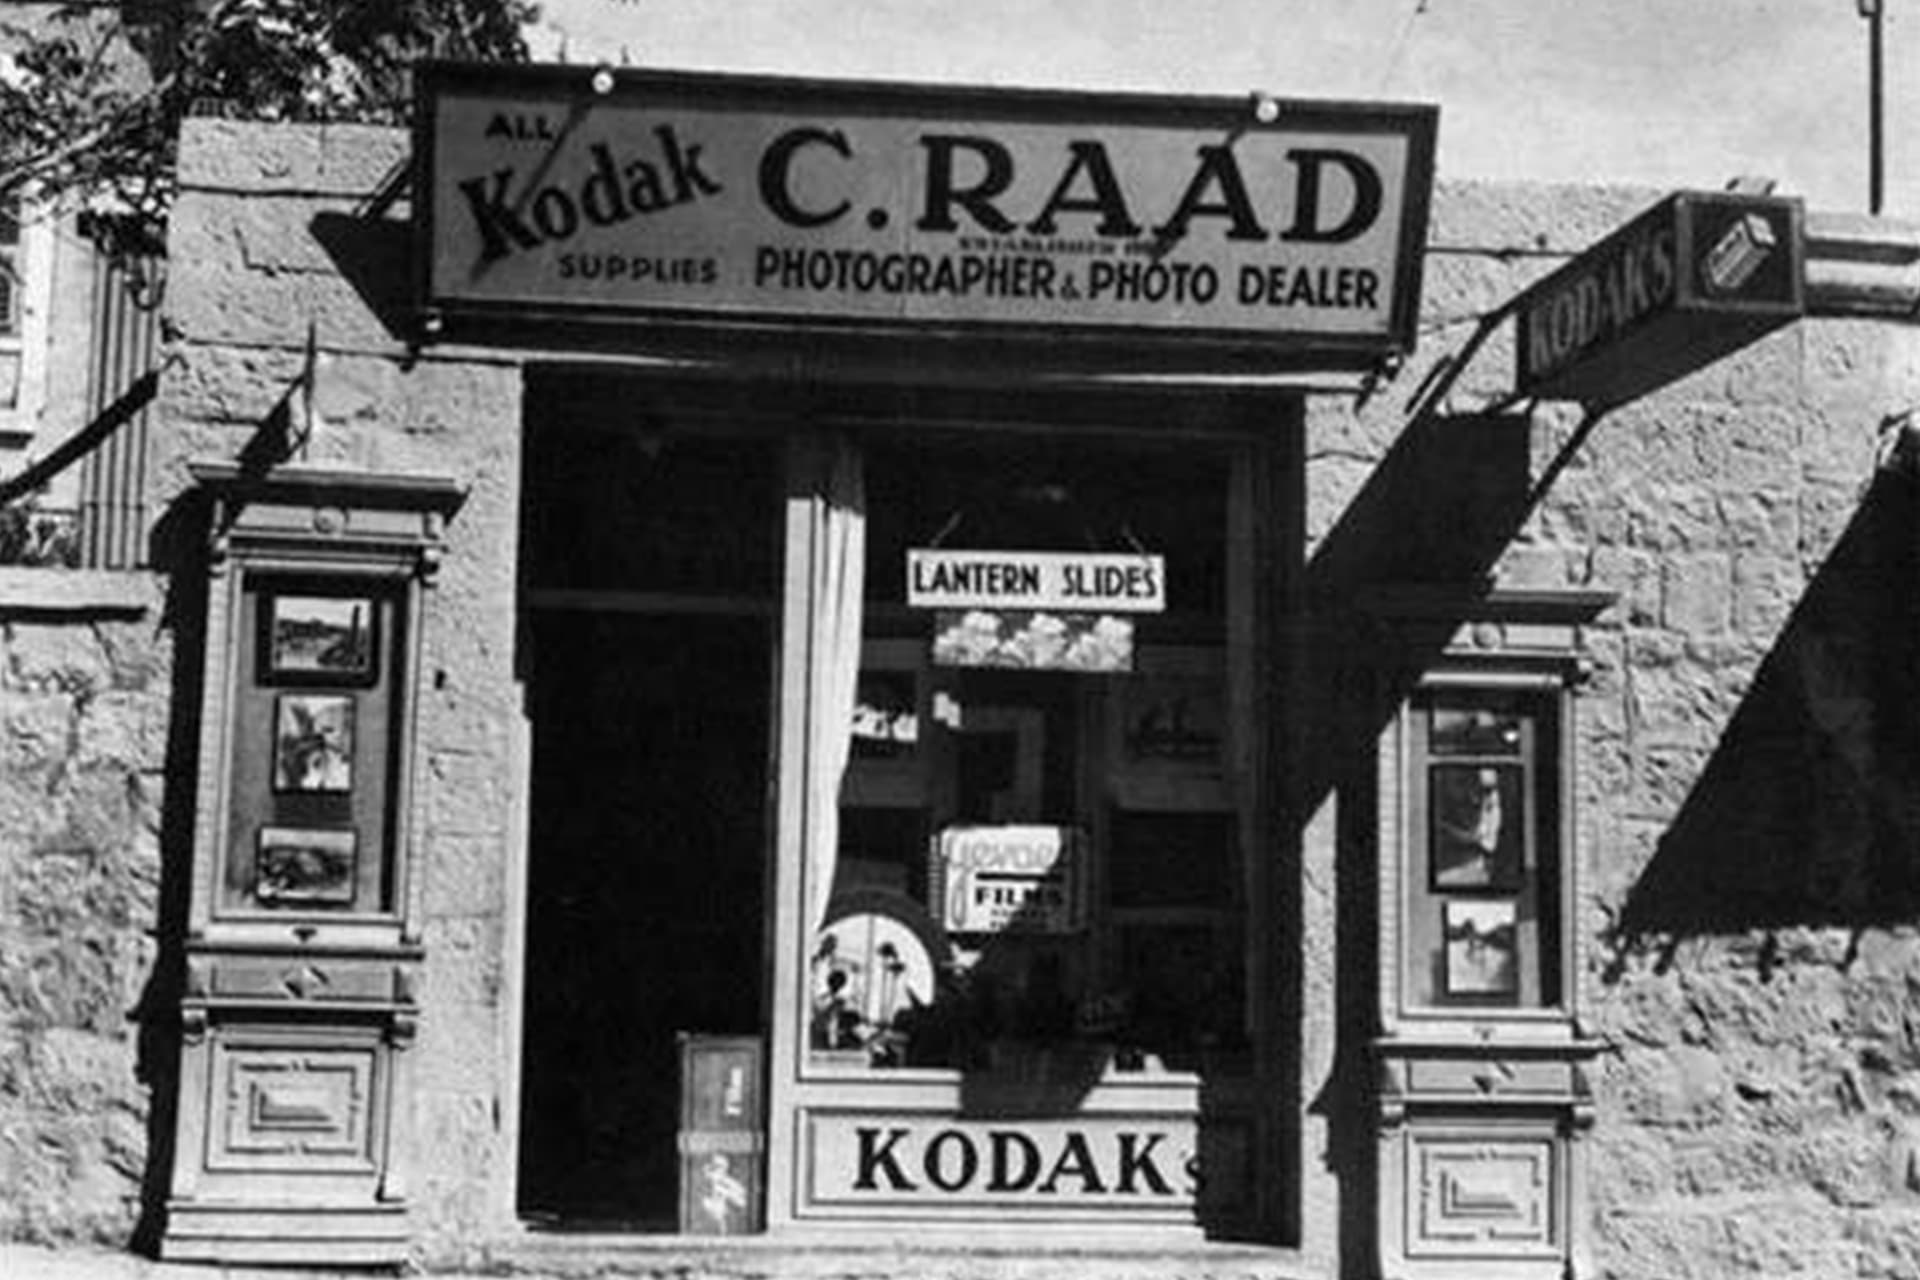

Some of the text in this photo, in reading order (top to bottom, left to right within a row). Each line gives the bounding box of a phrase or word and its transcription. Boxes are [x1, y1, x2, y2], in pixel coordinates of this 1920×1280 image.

[484, 113, 553, 141] ALL
[458, 123, 725, 263] Kodak
[557, 253, 717, 285] SUPPLIES
[754, 246, 1056, 300] PHOTOGRAPHER
[1060, 271, 1082, 300] &
[1088, 261, 1219, 304] PHOTO
[1238, 265, 1379, 309] DEALER
[913, 560, 1157, 598] LANTERN SLIDES
